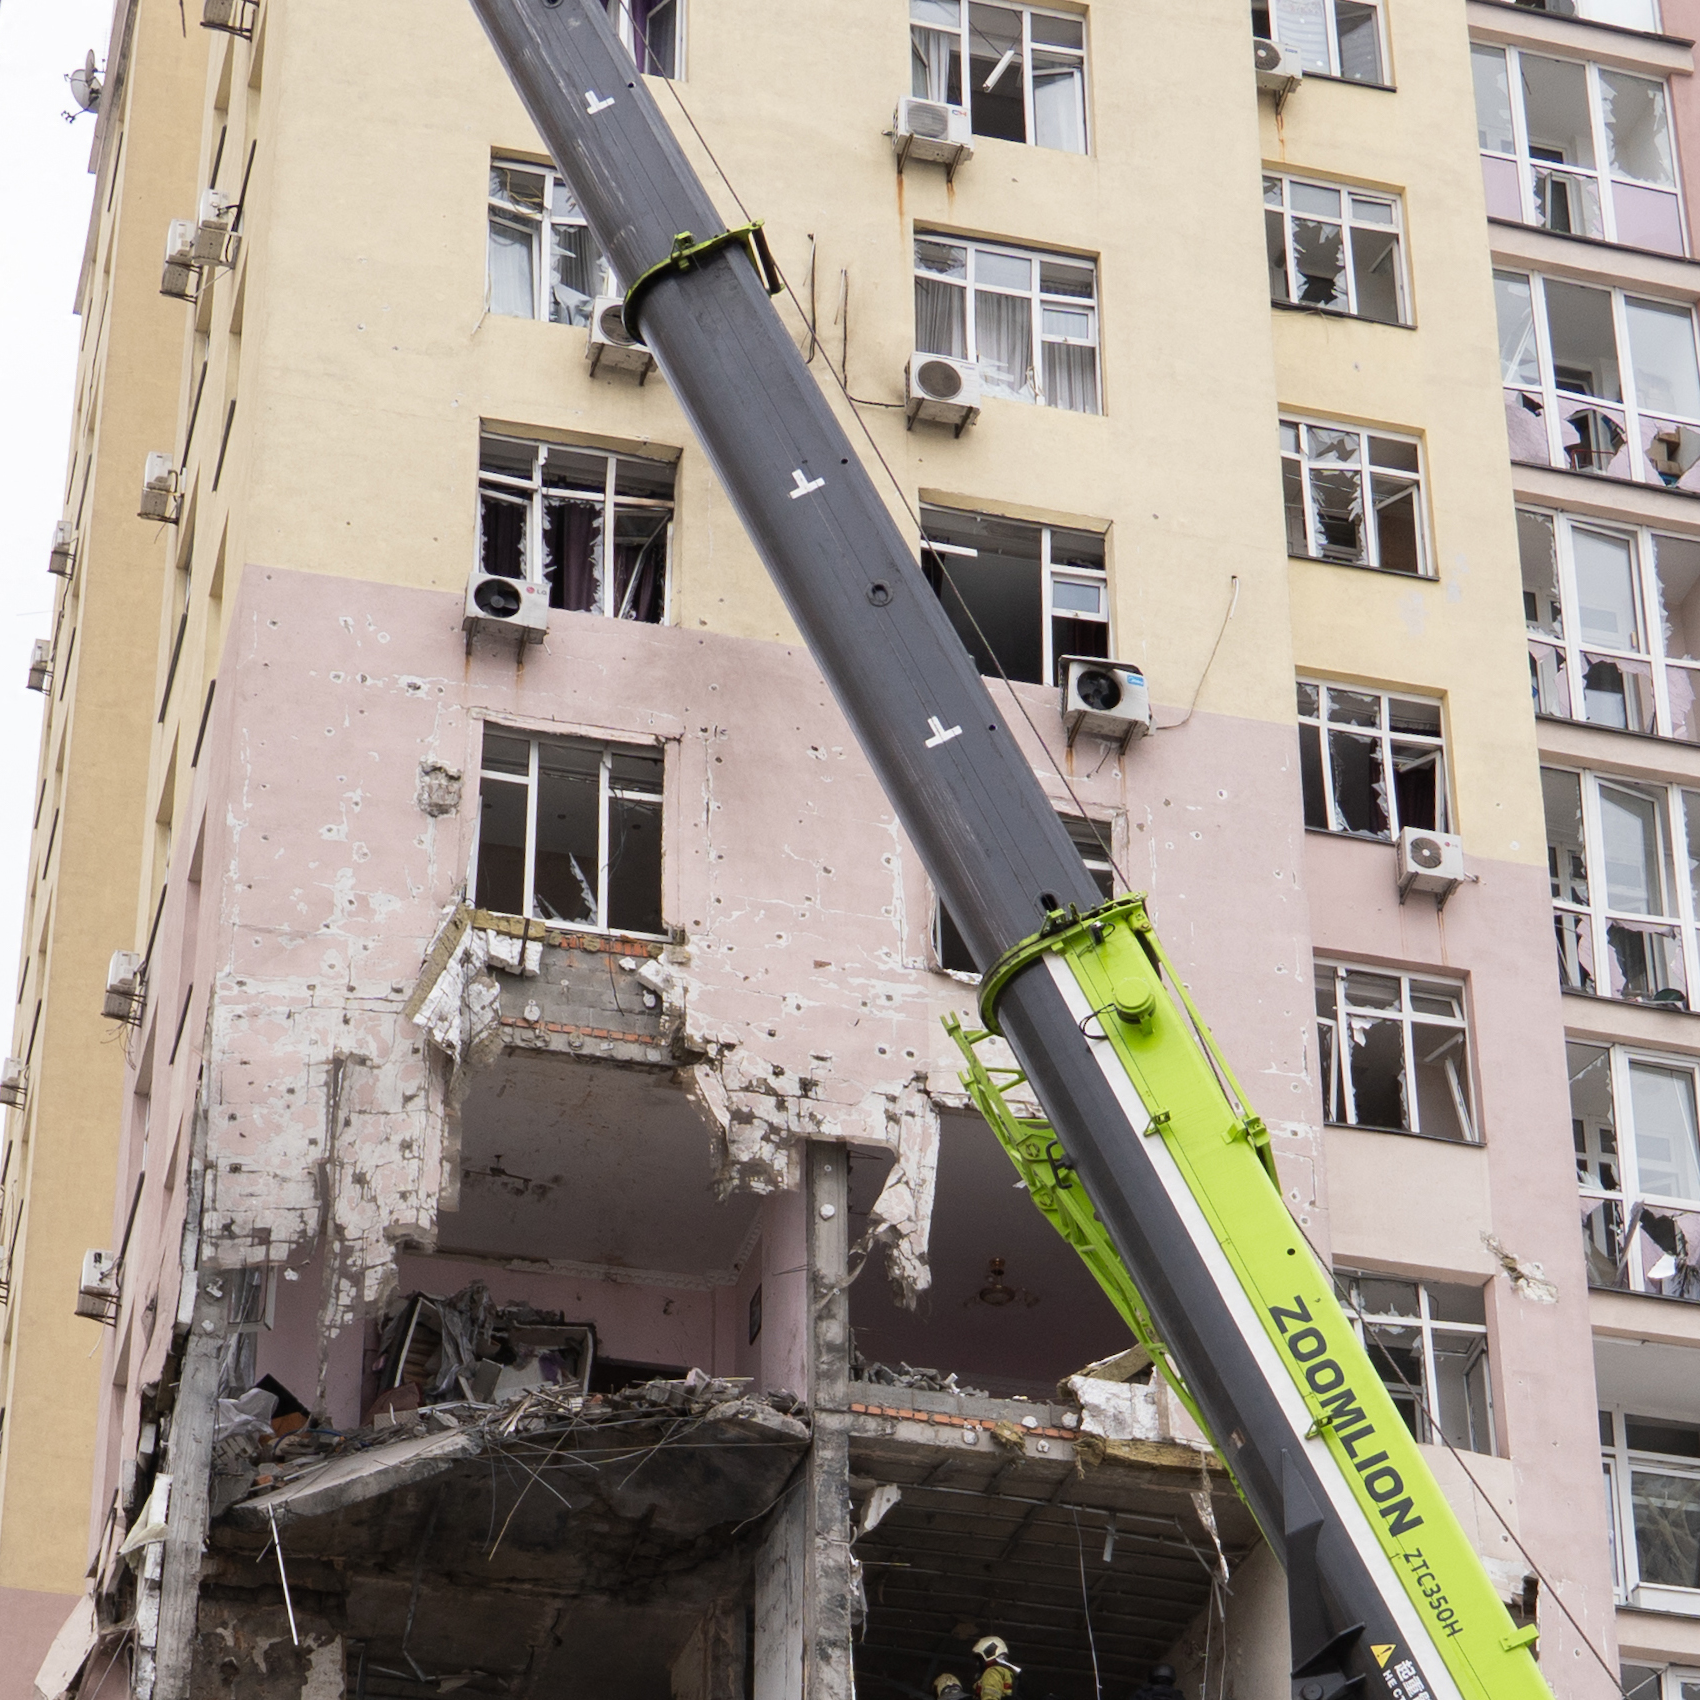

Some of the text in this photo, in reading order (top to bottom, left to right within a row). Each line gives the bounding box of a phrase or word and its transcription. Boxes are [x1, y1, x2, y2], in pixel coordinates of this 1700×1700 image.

[1268, 1295, 1464, 1638] ZOOMLION ZTC350H
[1382, 1669, 1398, 1689] НЕ
